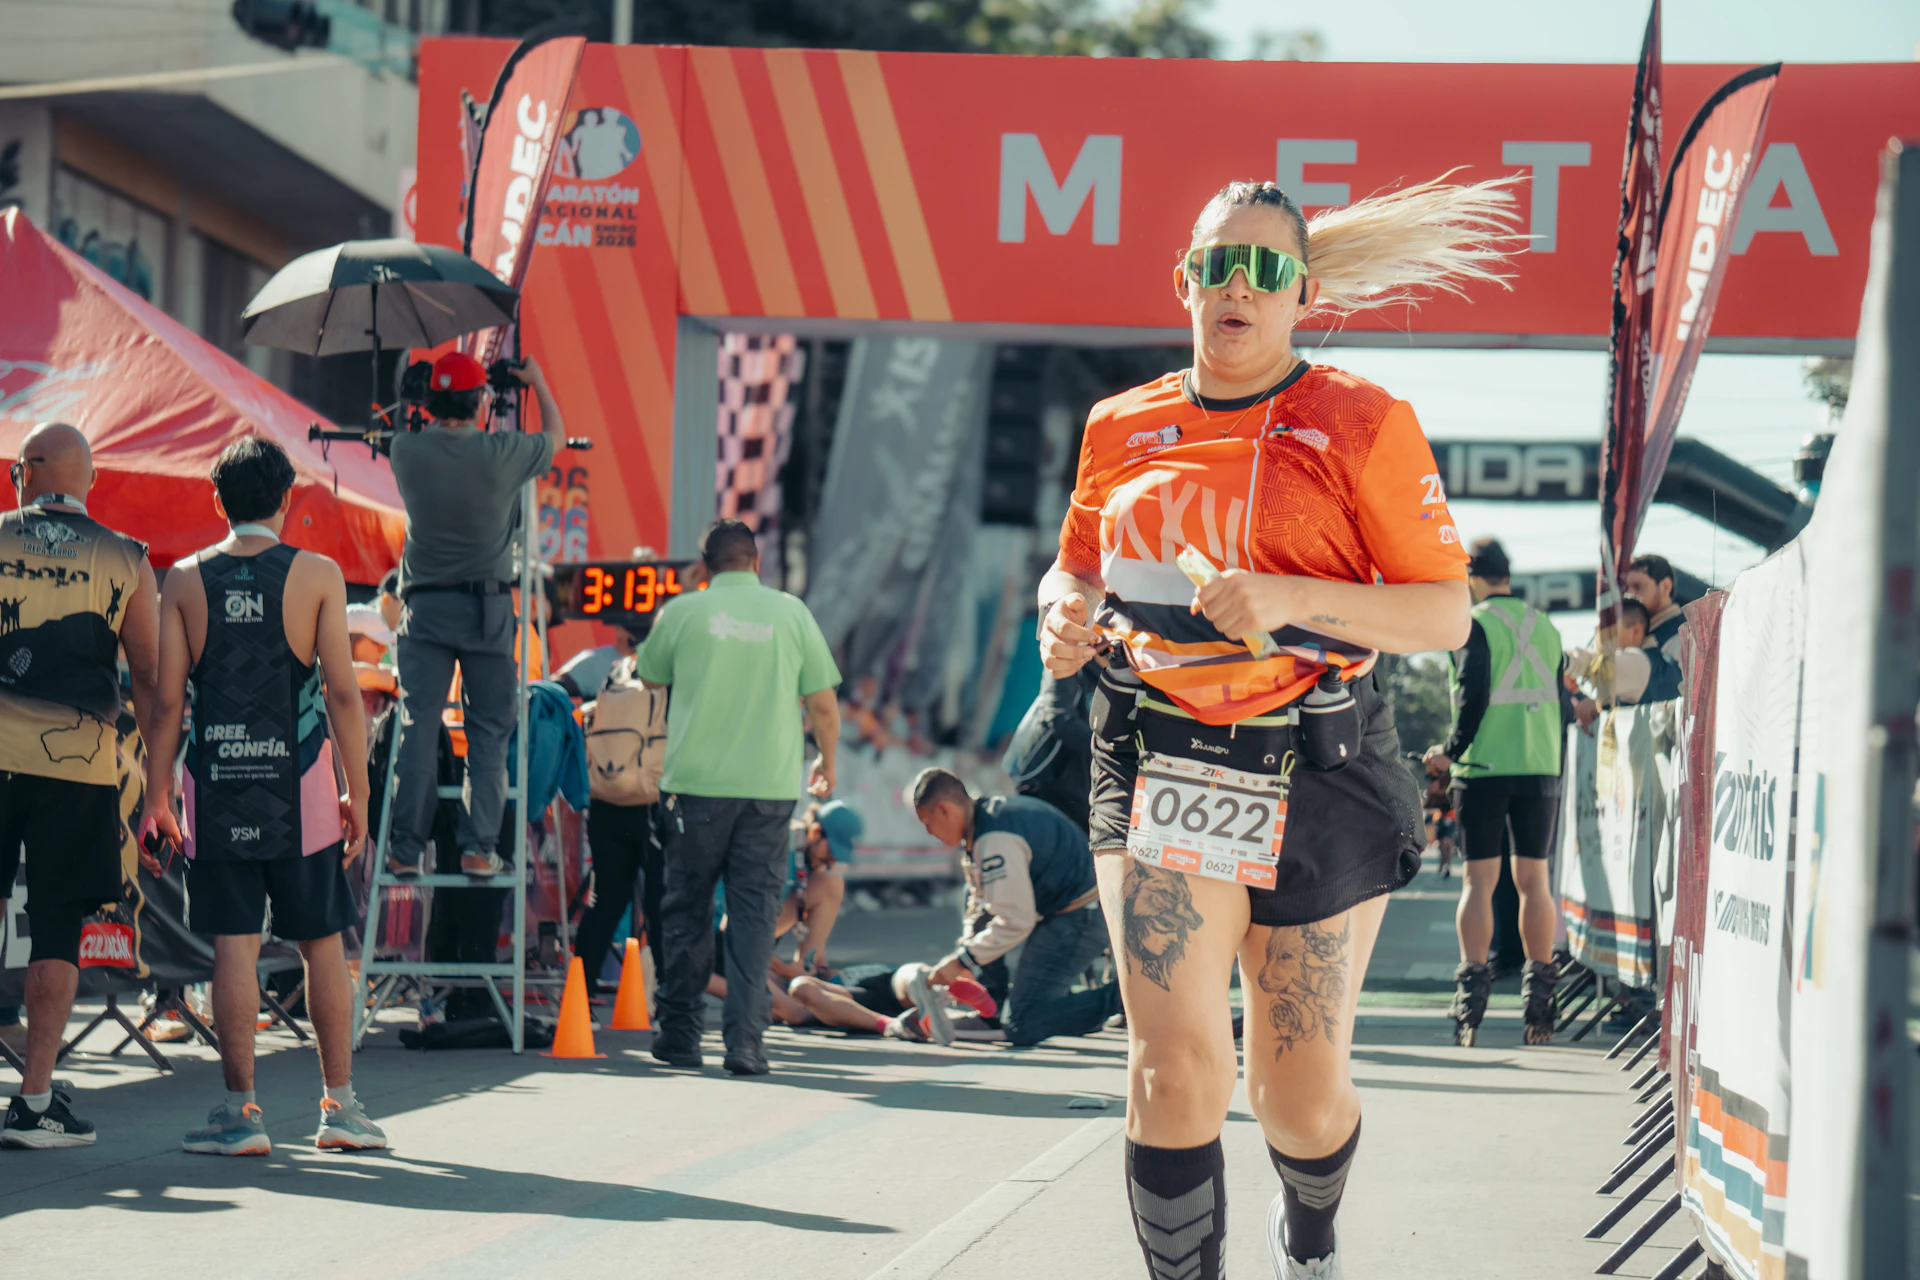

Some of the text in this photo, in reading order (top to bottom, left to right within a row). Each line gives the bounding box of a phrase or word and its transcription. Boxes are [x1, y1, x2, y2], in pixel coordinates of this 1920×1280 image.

[548, 183, 640, 205] ARATÓN
[1676, 144, 1734, 342] IMDEC
[1448, 445, 1584, 496] IDA
[225, 593, 264, 618] ON
[205, 723, 251, 742] CREE.
[218, 736, 290, 758] CONFÍA.
[1200, 766, 1228, 780] 21K
[1151, 787, 1270, 844] 0622
[1131, 844, 1159, 860] 0622
[1206, 860, 1234, 875] 0622
